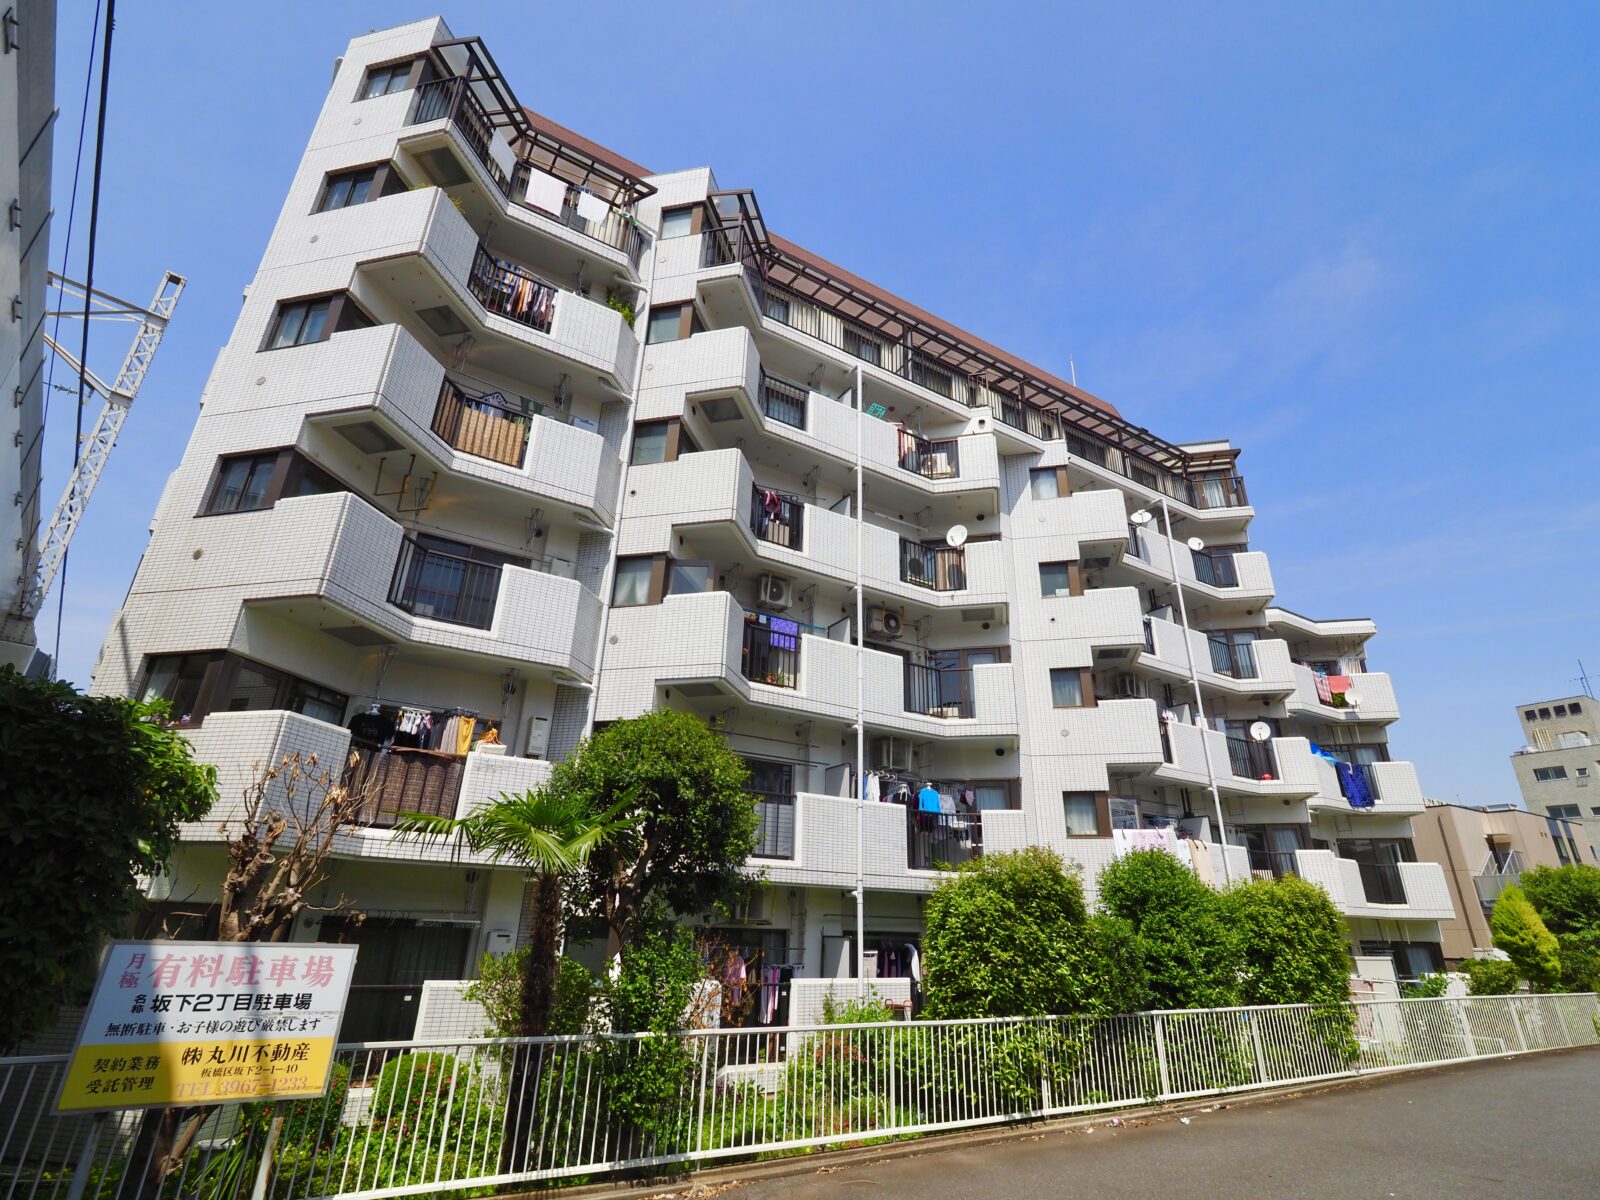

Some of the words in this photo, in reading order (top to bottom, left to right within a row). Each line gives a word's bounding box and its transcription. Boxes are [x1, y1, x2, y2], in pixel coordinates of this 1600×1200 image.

[118, 953, 146, 988] 月極
[146, 953, 335, 988] 有料駐車場
[130, 993, 148, 1014] 名称
[150, 992, 313, 1013] 坂下2丁目駐車場
[92, 1055, 161, 1073] 契約業務
[85, 1076, 155, 1094] 受託管理
[176, 1081, 212, 1097] TEL
[217, 1076, 308, 1096] 3967-1233
